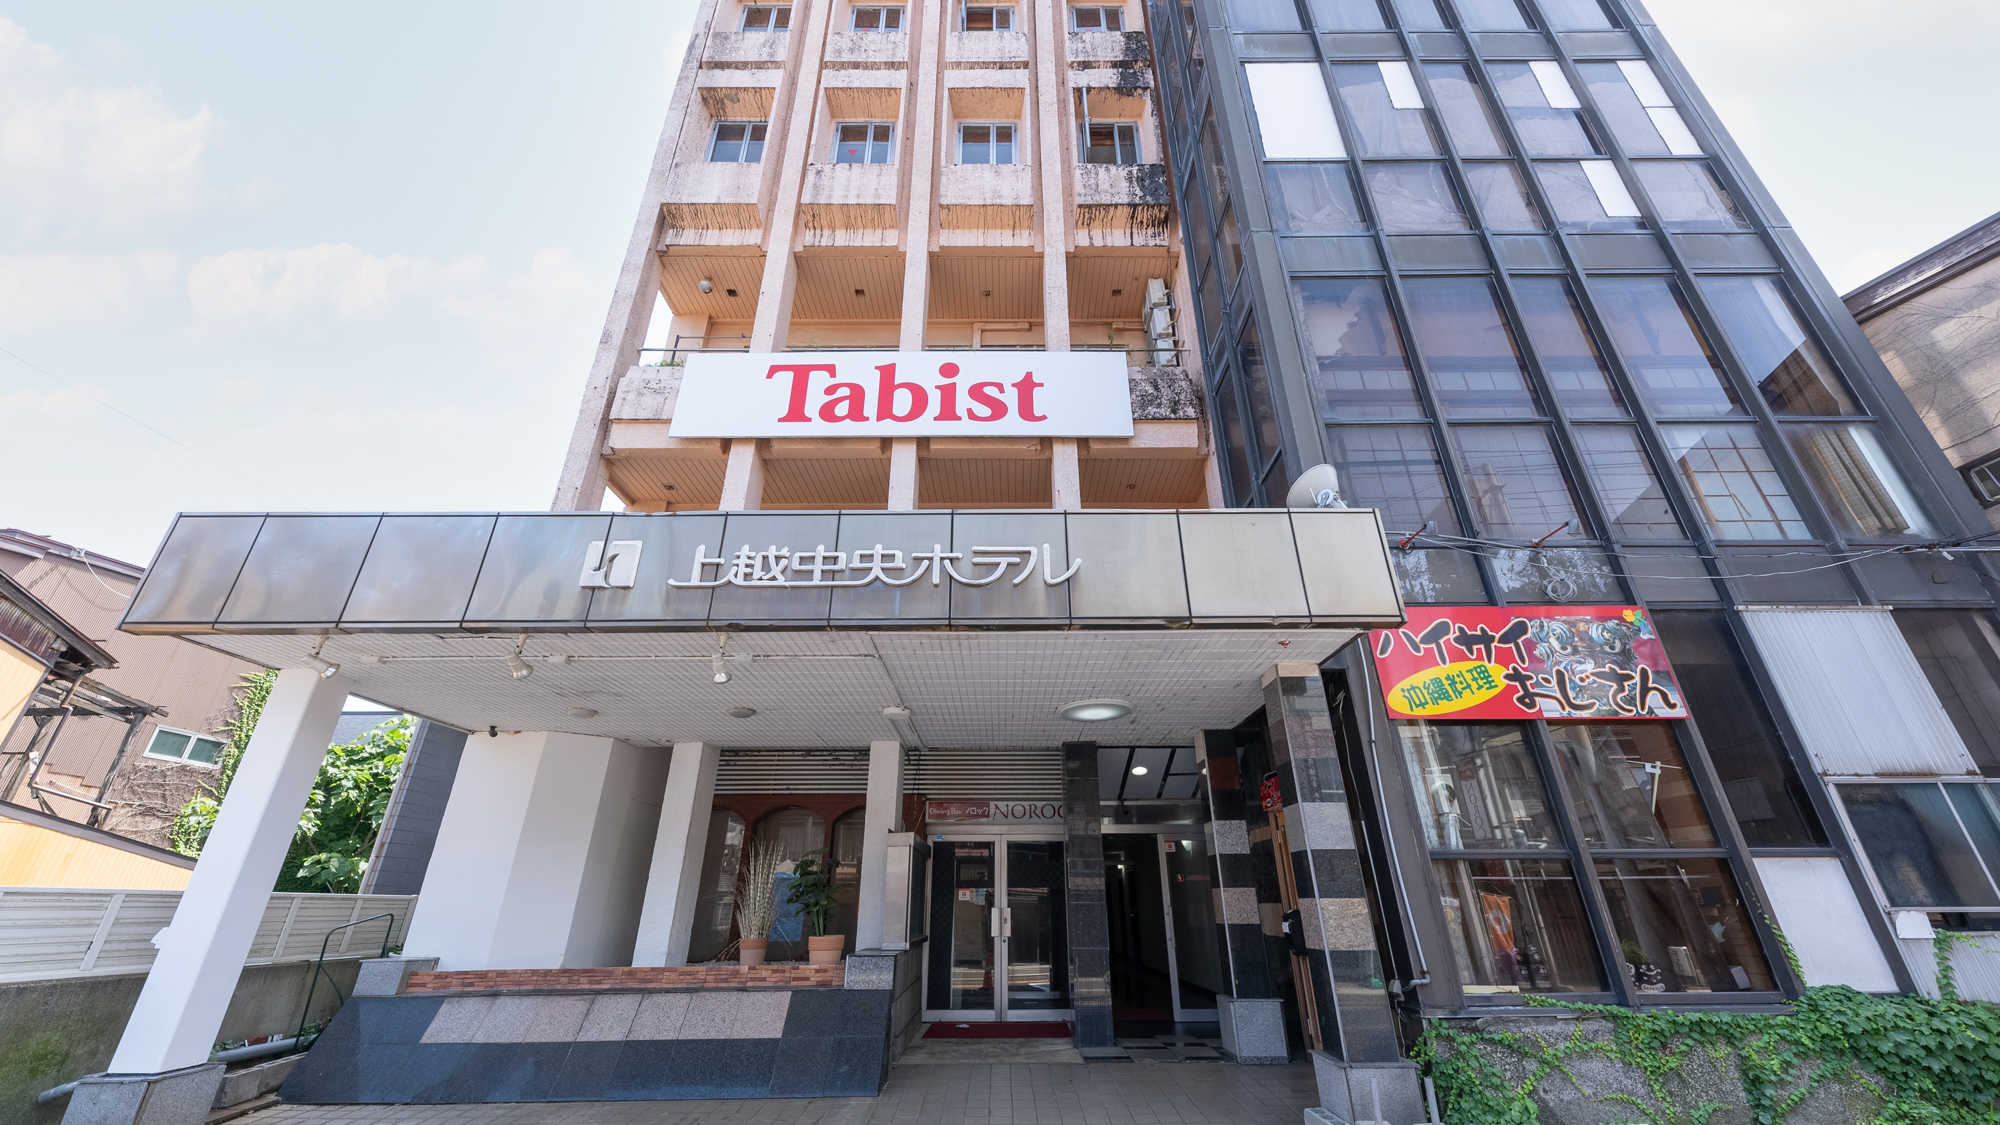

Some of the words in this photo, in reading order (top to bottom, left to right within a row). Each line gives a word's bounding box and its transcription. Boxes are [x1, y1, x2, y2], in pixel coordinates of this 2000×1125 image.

[765, 362, 1048, 423] Tabist
[667, 543, 1082, 588] 上越中央ホテル
[1376, 618, 1530, 667] ハイサイ
[1400, 664, 1499, 712] 沖縄料理
[1501, 663, 1680, 714] おじさん
[929, 807, 950, 815] Dining
[951, 807, 963, 815] Bar
[965, 807, 989, 815] ノロック
